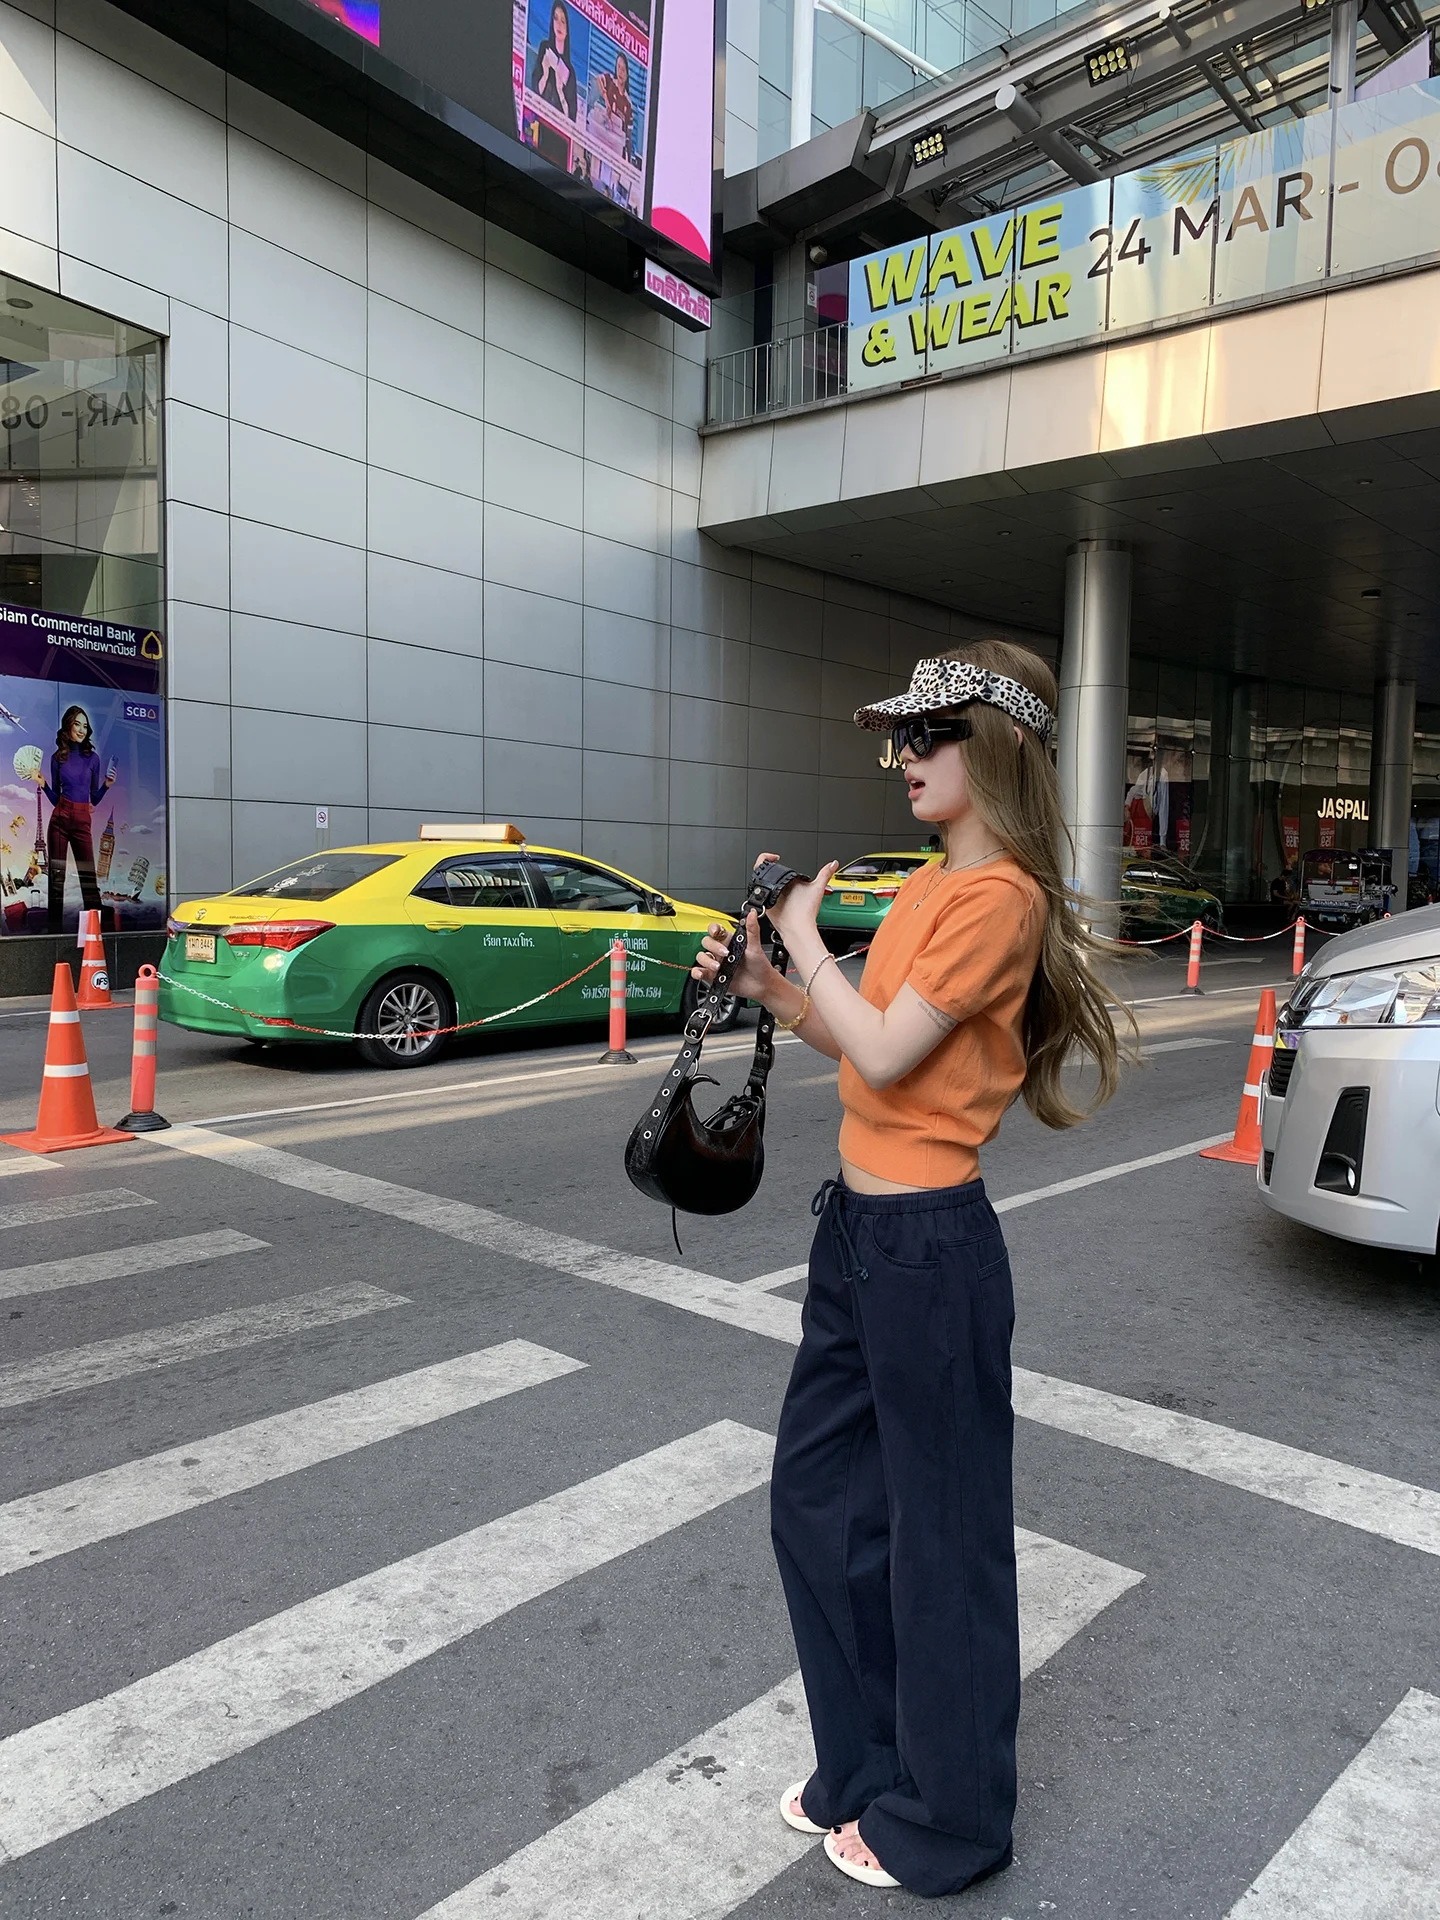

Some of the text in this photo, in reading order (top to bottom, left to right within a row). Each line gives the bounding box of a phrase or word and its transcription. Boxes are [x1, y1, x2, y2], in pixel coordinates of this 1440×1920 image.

[1086, 216, 1152, 280] 24
[1173, 172, 1313, 256] MAR
[864, 202, 1064, 313] WAVE
[862, 272, 1073, 367] & WEAR
[31, 613, 103, 638] Commercial
[106, 626, 136, 643] Bank
[47, 634, 137, 657] ธนาคารไทยพาณิชย์
[126, 706, 147, 718] SCB
[1317, 797, 1369, 821] JASPAL
[483, 933, 501, 947] เรียก
[502, 937, 520, 947] TAXI
